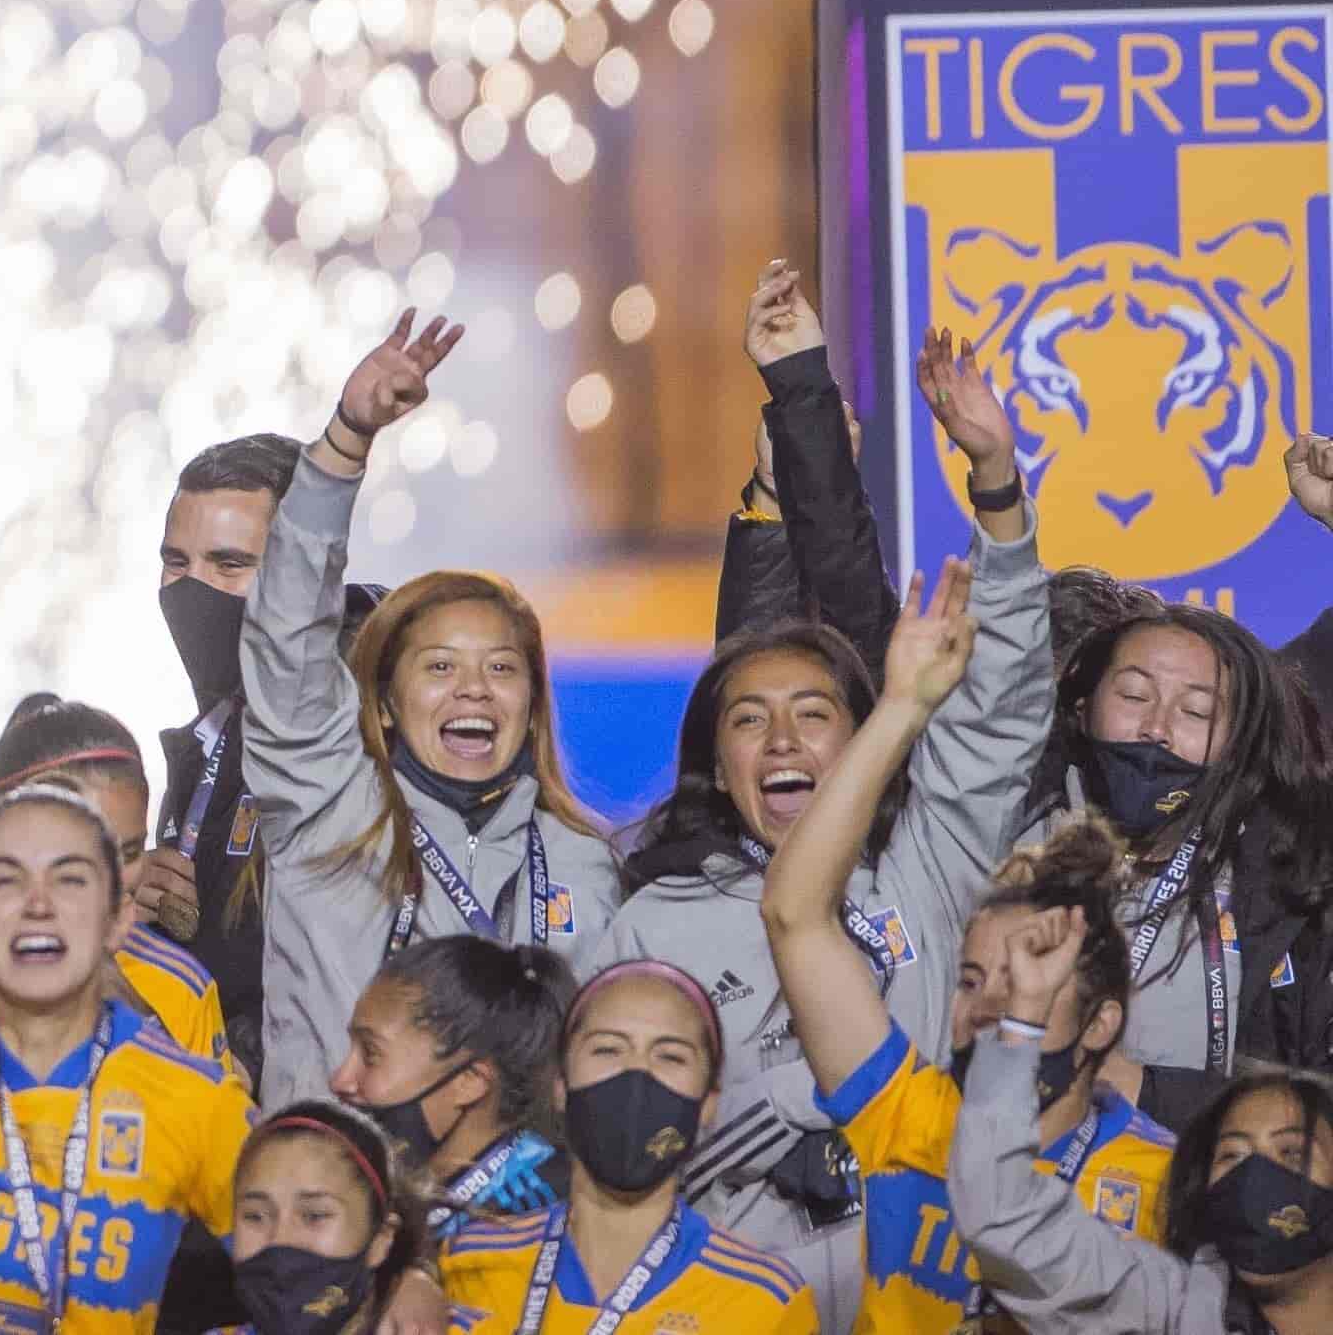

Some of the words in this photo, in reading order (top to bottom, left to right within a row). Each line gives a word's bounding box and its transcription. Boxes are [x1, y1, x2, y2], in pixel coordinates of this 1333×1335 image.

[903, 27, 1325, 140] TIGRES
[422, 847, 459, 892] BBVA
[450, 885, 480, 918] MX
[1130, 879, 1179, 971] UARDNES
[1169, 843, 1196, 879] 2020
[847, 911, 886, 948] 2020
[715, 984, 755, 1006] didas
[1211, 967, 1225, 1010] BBVA
[1212, 1031, 1225, 1064] LIGA
